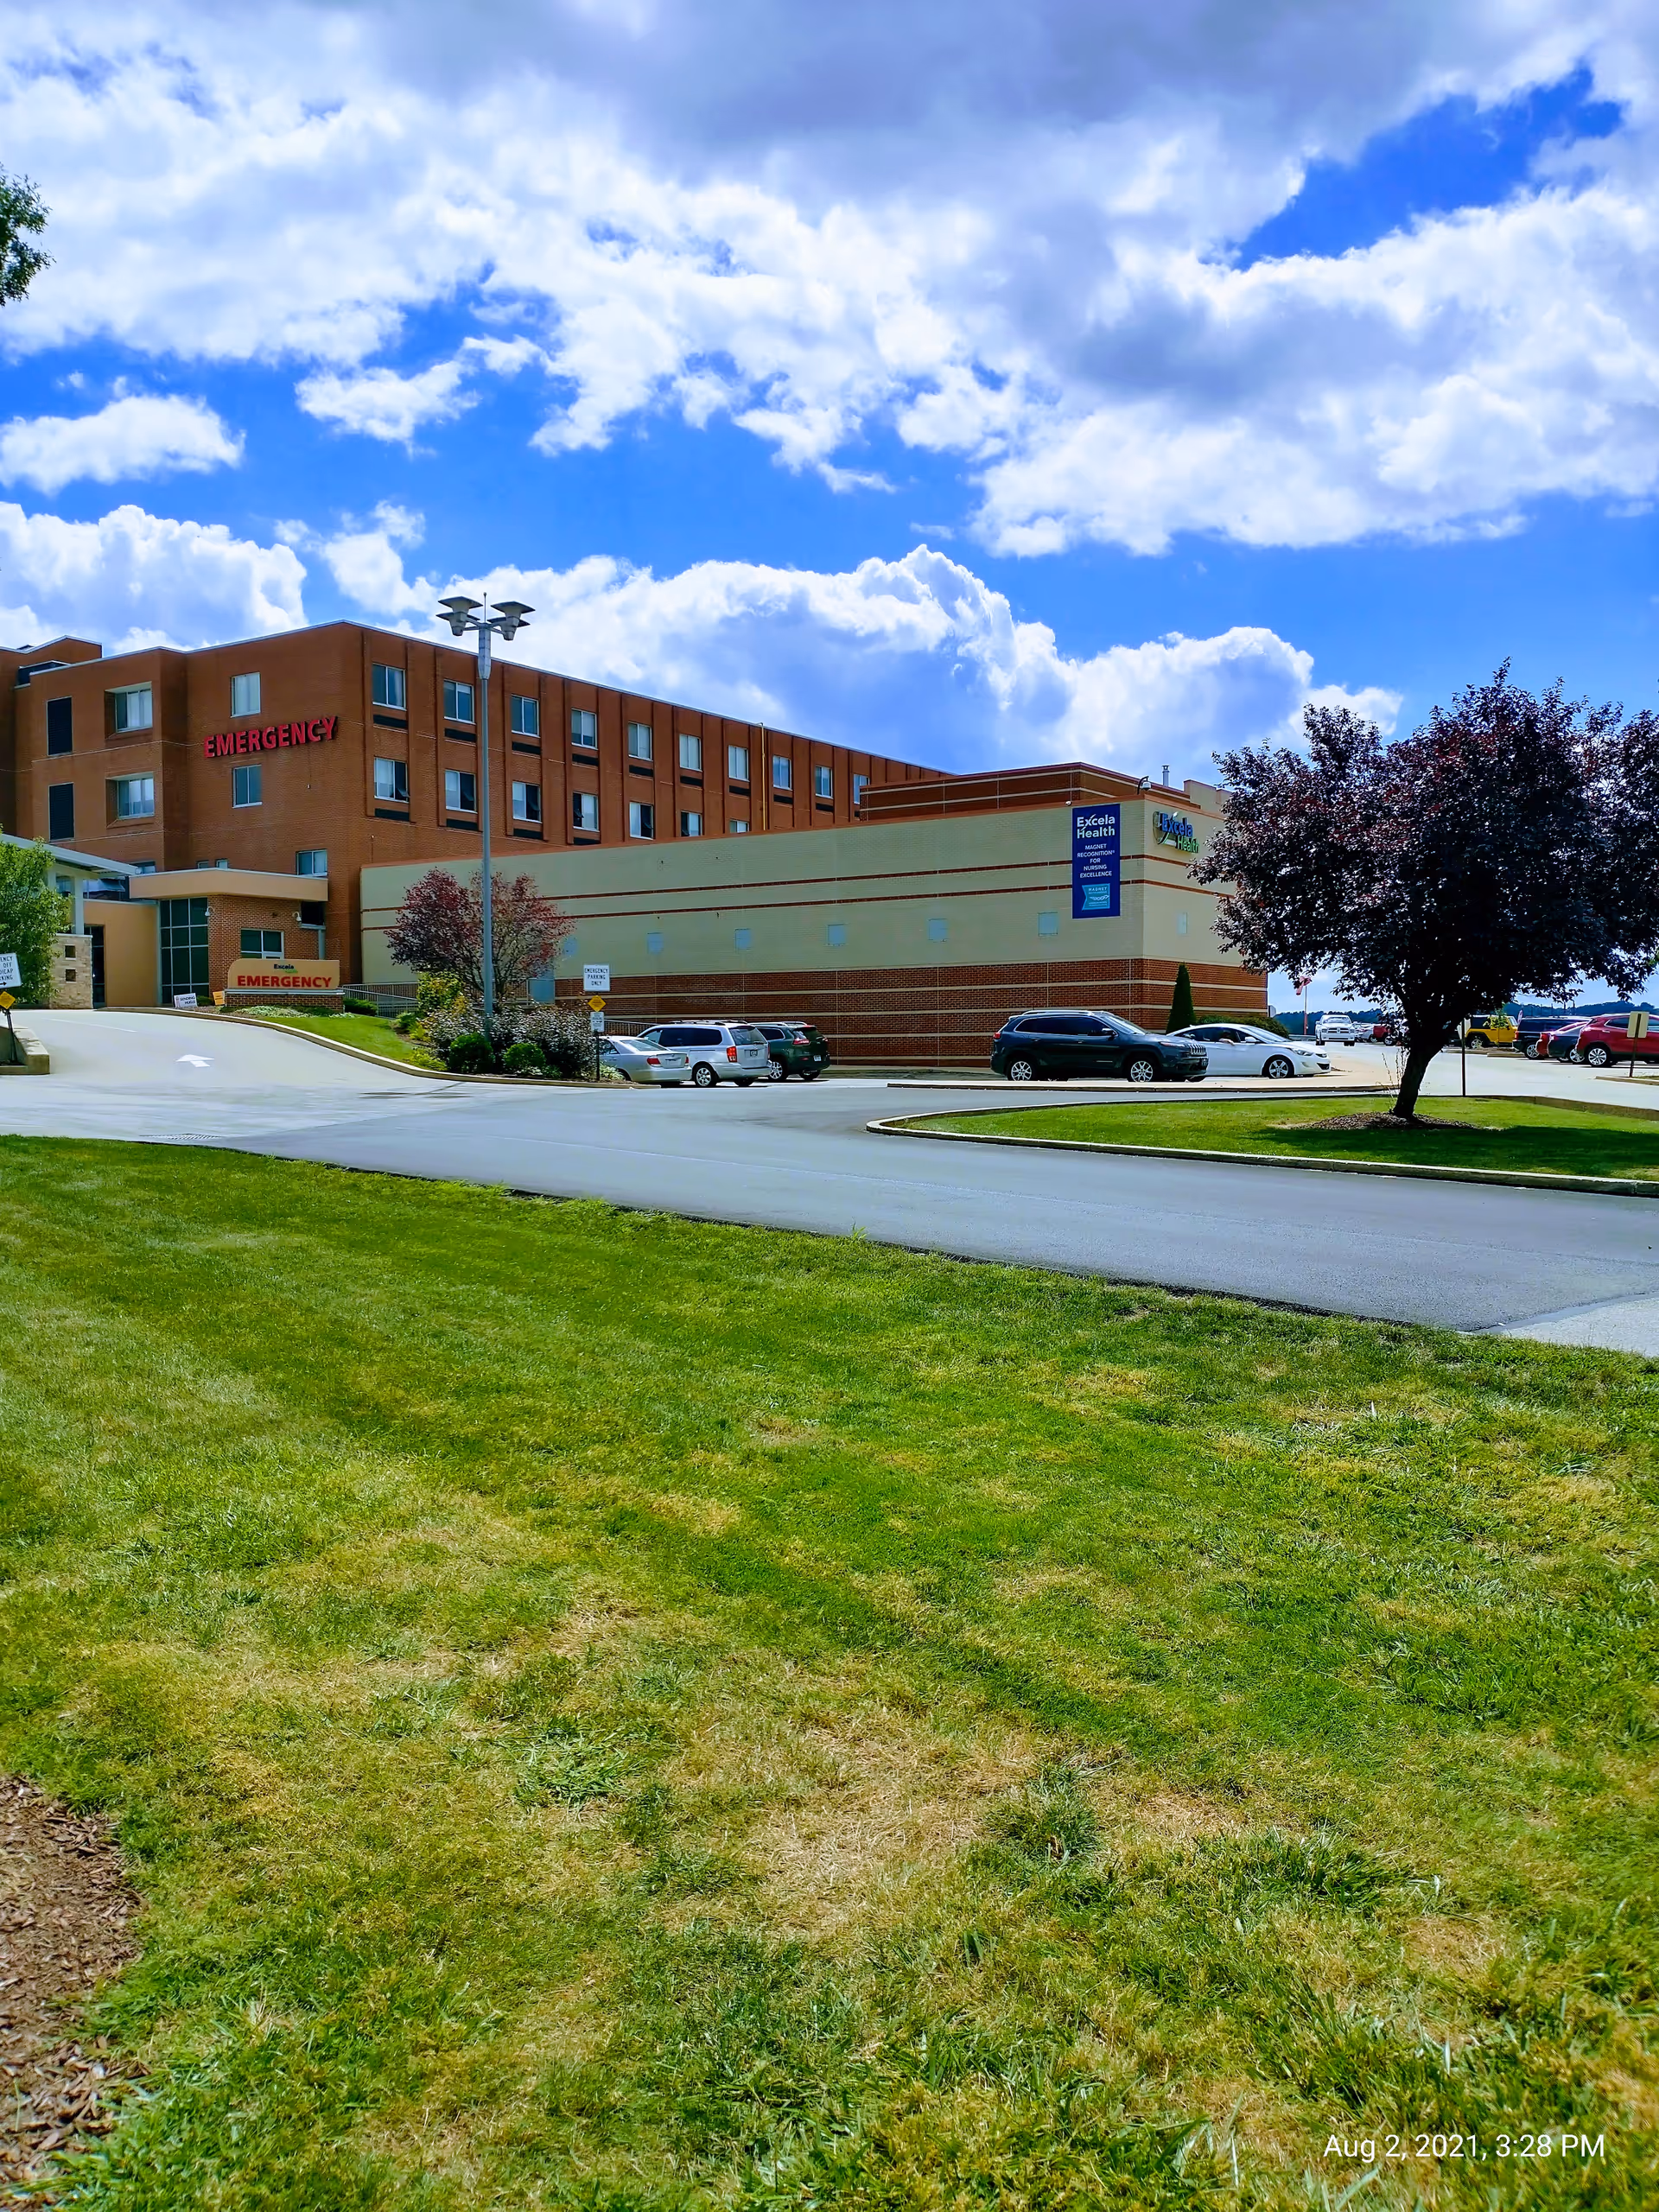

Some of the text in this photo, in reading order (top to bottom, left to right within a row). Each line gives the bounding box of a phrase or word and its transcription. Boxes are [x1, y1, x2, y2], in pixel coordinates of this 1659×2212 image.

[203, 716, 338, 758] EMERGENCY
[1077, 814, 1116, 827] Excela
[1160, 812, 1193, 837] Excela
[1077, 826, 1116, 838] Health
[237, 975, 332, 988] EMERGENCY
